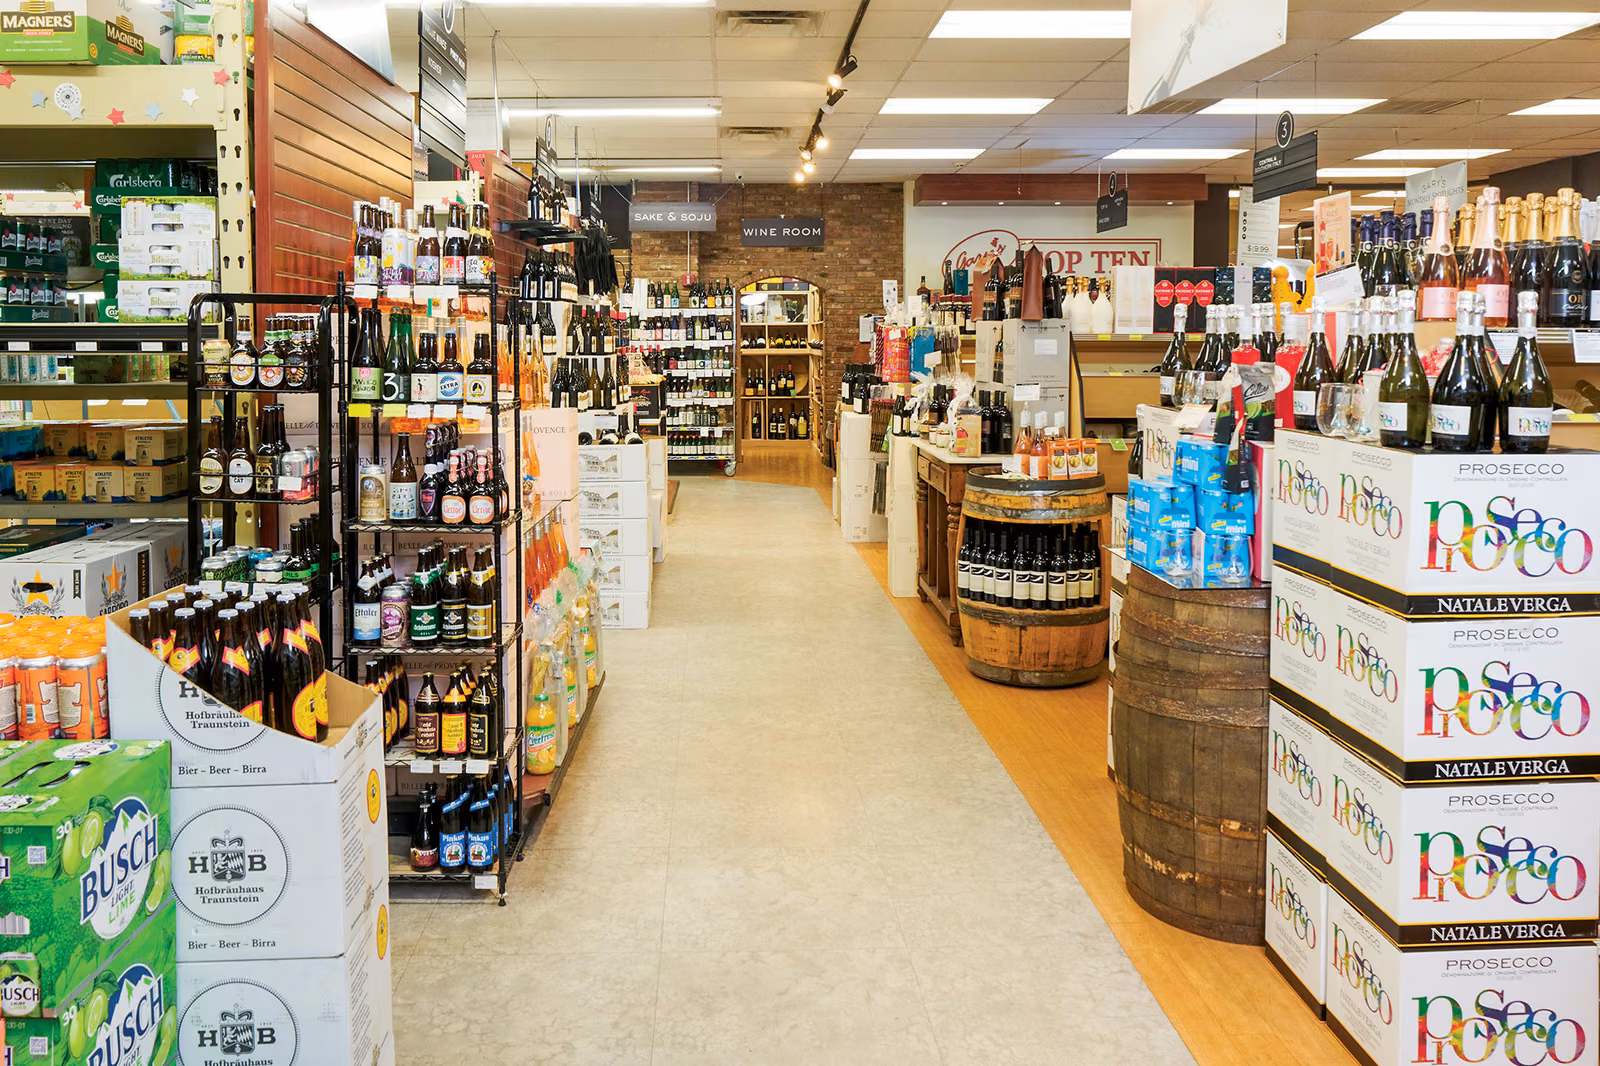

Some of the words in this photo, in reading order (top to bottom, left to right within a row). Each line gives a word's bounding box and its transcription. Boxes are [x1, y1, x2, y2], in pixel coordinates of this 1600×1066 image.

[3, 14, 73, 28] MAGNERS
[107, 24, 143, 52] MAGNERS
[1281, 121, 1288, 138] 3
[96, 194, 121, 203] Carlsber
[634, 213, 663, 222] SAKE
[667, 212, 677, 222] &
[680, 213, 712, 222] SOJU
[743, 228, 777, 237] WINE
[782, 228, 821, 236] ROOM
[1247, 244, 1269, 253] $19.99
[96, 251, 120, 261] Carlsbe
[440, 382, 458, 390] EXTRA
[1352, 451, 1392, 466] PROSECCO
[1459, 463, 1565, 475] PROSECCO
[1172, 519, 1190, 529] mini
[1348, 605, 1387, 629] PROSECCO
[1454, 627, 1559, 641] PROSECCO
[179, 681, 199, 697] H
[186, 711, 242, 720] Hofbräuha
[190, 720, 250, 729] Traunstein
[178, 765, 198, 775] Bier
[209, 765, 231, 775] Beer
[242, 764, 267, 774] Birra
[1449, 793, 1554, 806] PROSECCO
[56, 820, 73, 840] 30
[443, 834, 465, 842] Pinkus
[83, 819, 157, 922] BUSCH
[111, 881, 134, 907] LIGHT
[195, 886, 264, 895] Hofbräuhaus
[200, 896, 259, 904] Traunstein
[109, 893, 135, 924] LIME
[188, 941, 207, 950] Bier
[219, 940, 241, 949] Beer
[252, 939, 276, 948] Birra
[1446, 957, 1553, 970] PROSECCO
[1, 987, 40, 1002] USCH
[62, 1005, 77, 1026] 30
